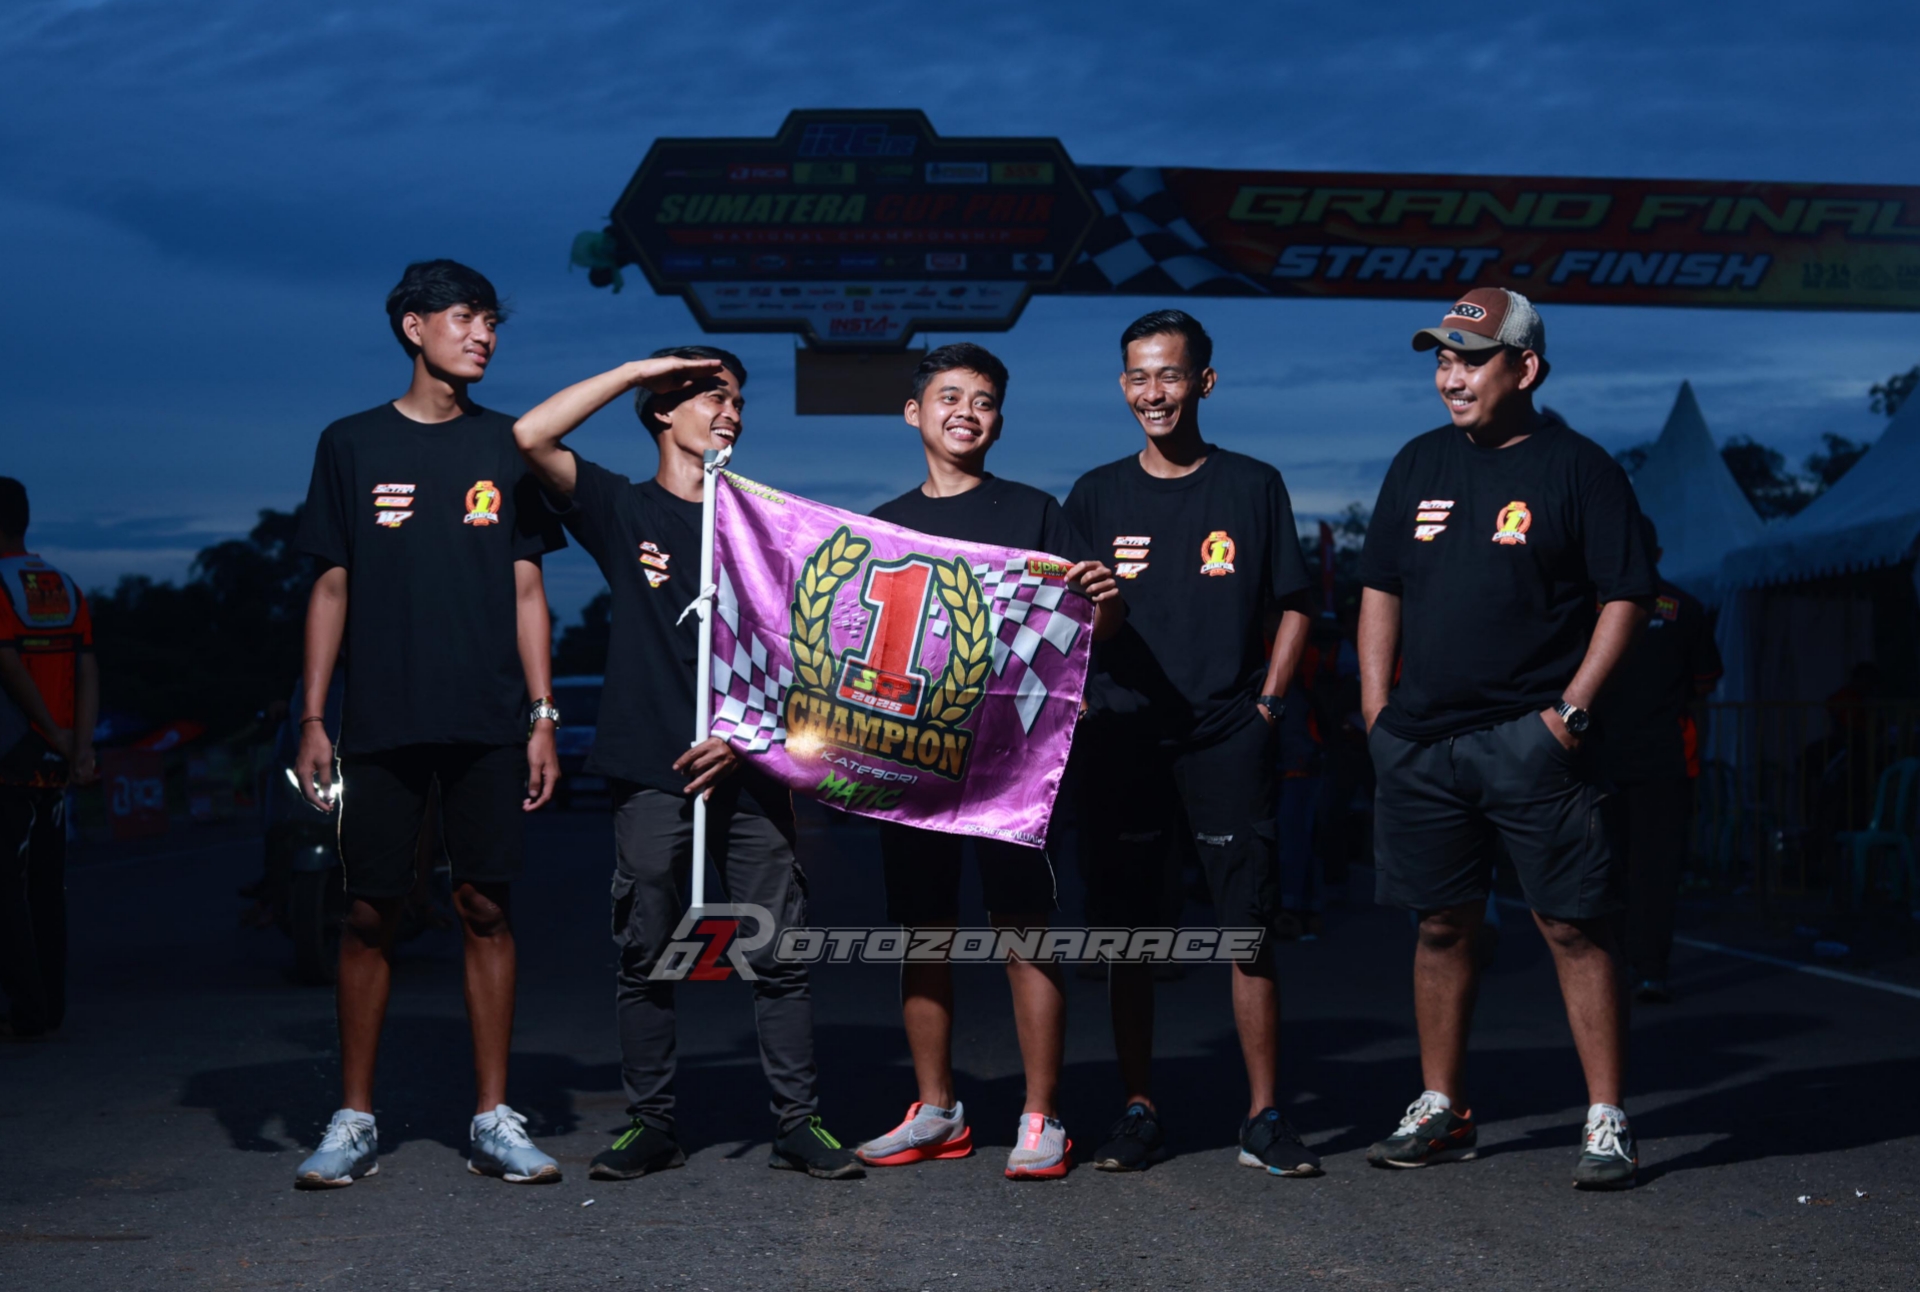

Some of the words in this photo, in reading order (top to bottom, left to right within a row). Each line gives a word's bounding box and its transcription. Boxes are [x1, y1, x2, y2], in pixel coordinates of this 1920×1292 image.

[655, 194, 868, 224] SUMATERA
[873, 194, 958, 224] CUP
[961, 194, 1056, 224] PRIX
[1227, 185, 1614, 230] GRAND
[1630, 194, 1920, 237] FINAL
[712, 231, 823, 242] NATIONAL
[838, 231, 1011, 242] CHAMPIONSHIP
[1270, 244, 1502, 284] START
[1550, 250, 1774, 288] FINISH
[727, 479, 787, 505] SUMATERA
[851, 690, 903, 712] 2025
[852, 669, 912, 701] SCP
[785, 689, 968, 777] CHAMPION
[816, 769, 905, 810] MATIC
